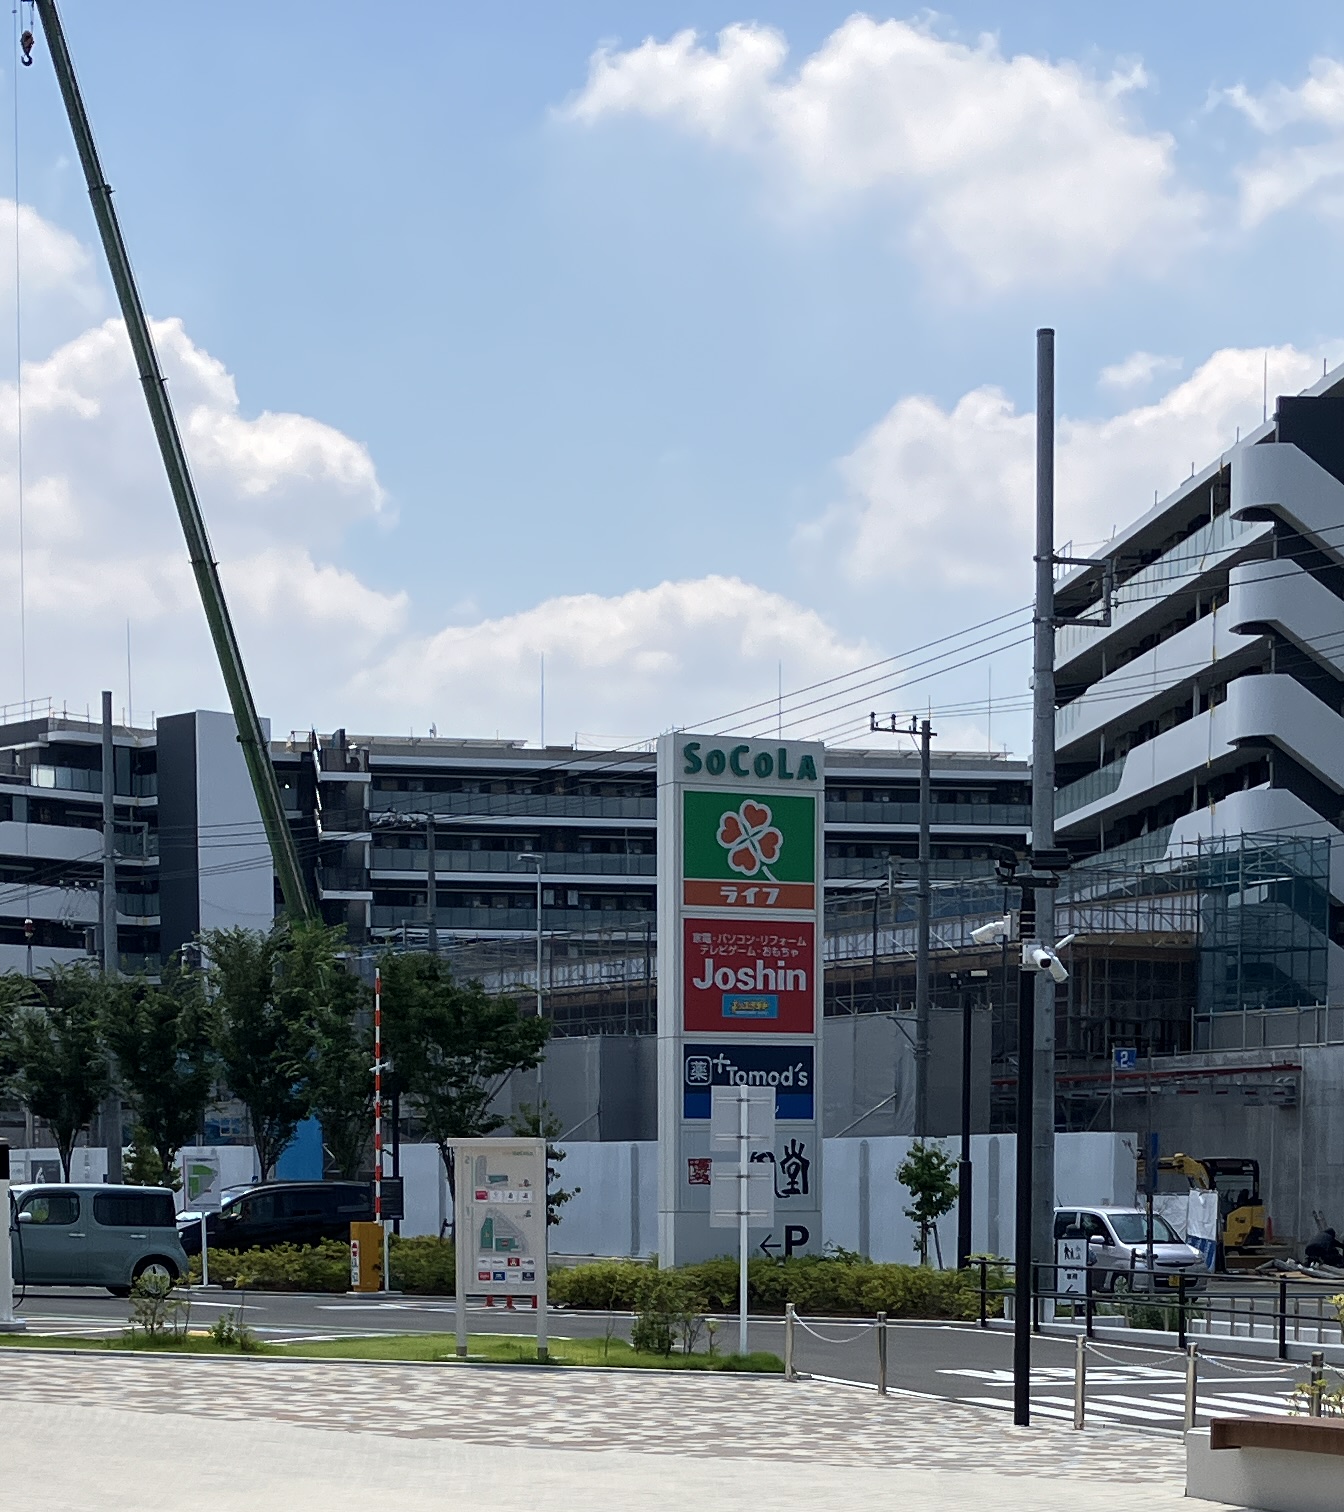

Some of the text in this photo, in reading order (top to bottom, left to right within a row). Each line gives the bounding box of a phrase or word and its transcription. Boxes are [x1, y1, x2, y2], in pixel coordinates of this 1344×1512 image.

[719, 886, 780, 906] ライフ
[692, 958, 807, 992] Joshin
[689, 1060, 708, 1081] 薬
[726, 1062, 809, 1087] Tomod's
[784, 1225, 810, 1256] P
